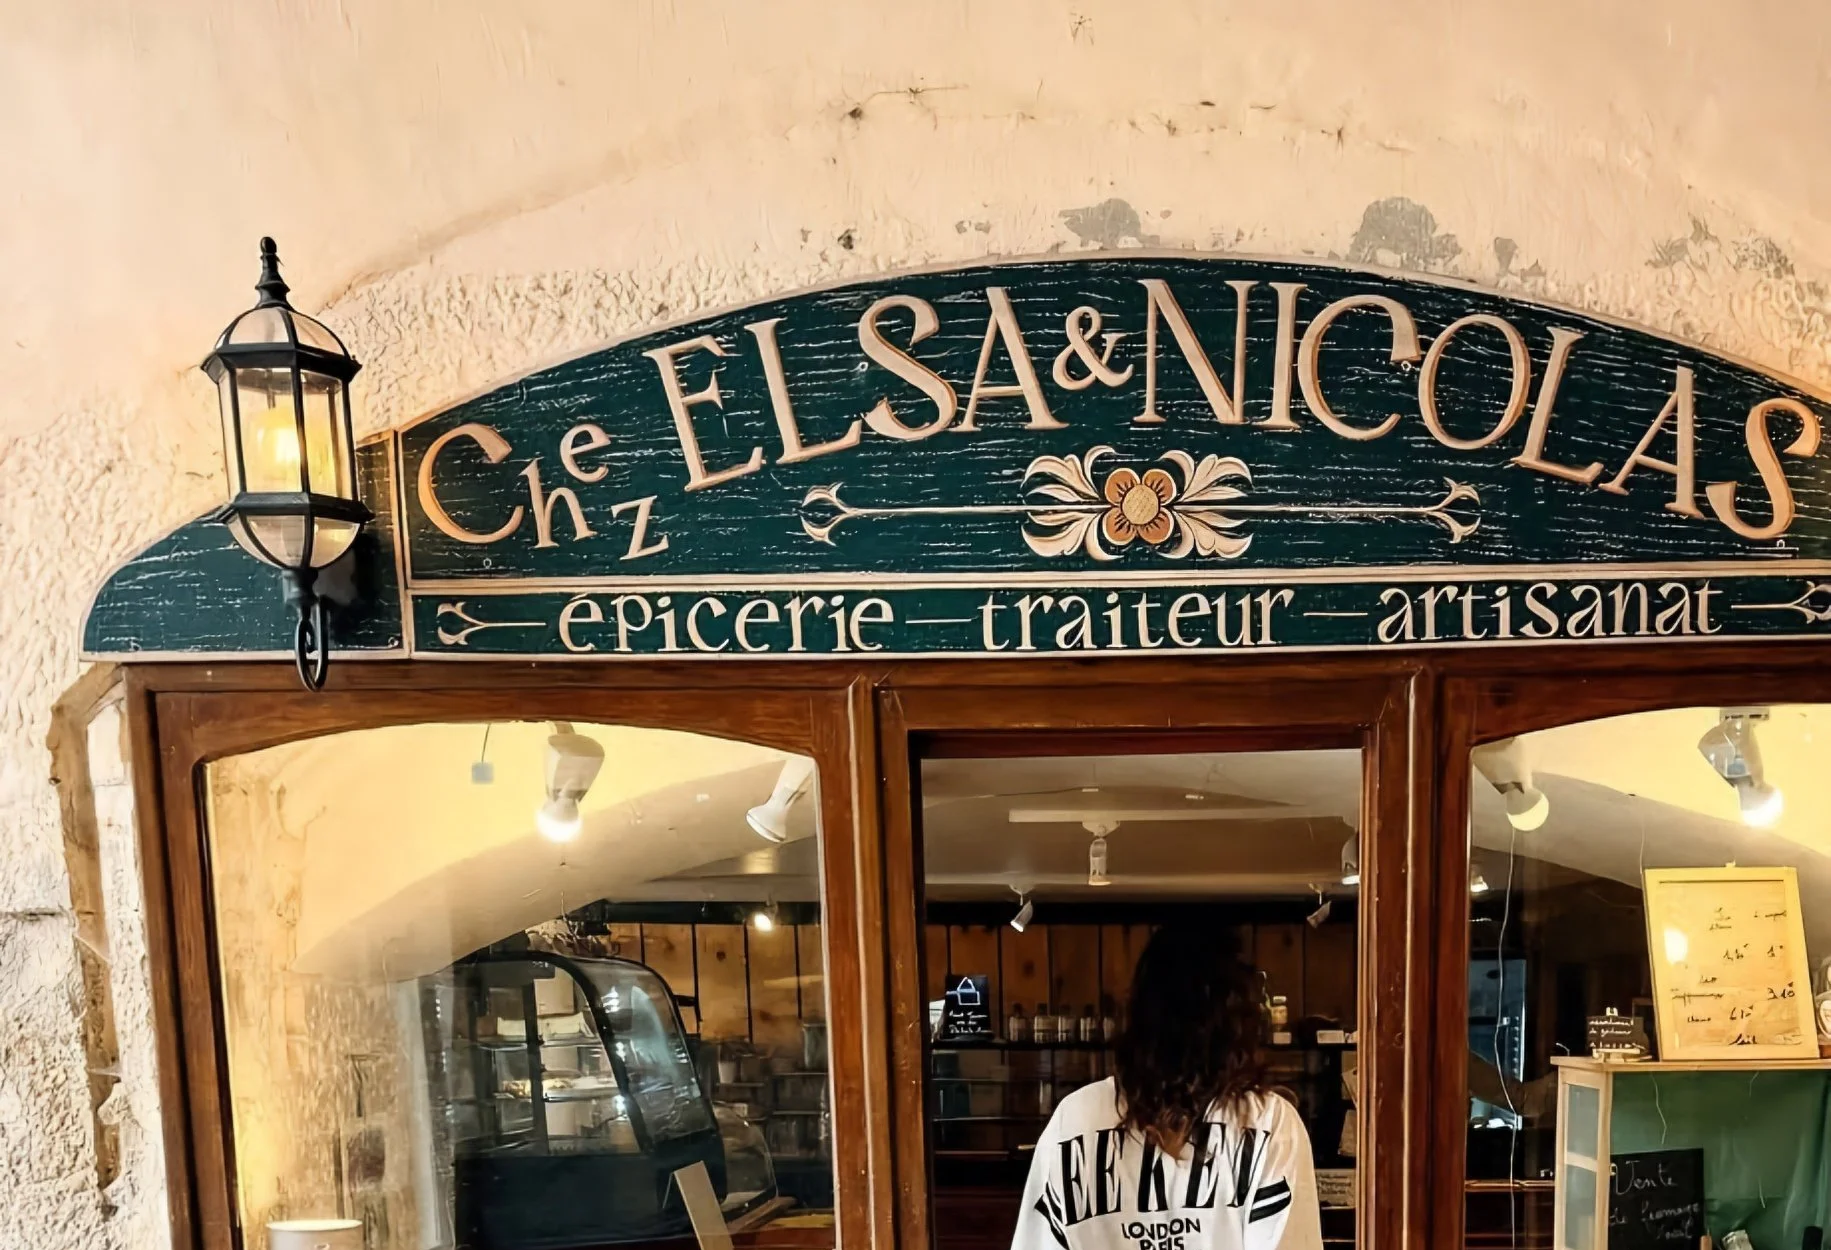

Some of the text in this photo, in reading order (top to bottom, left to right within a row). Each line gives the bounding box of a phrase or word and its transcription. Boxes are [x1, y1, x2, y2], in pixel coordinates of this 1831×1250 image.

[418, 422, 669, 561] Chez
[558, 581, 1724, 653] épicerie traiteur artisanat
[1121, 1217, 1201, 1240] LONDON
